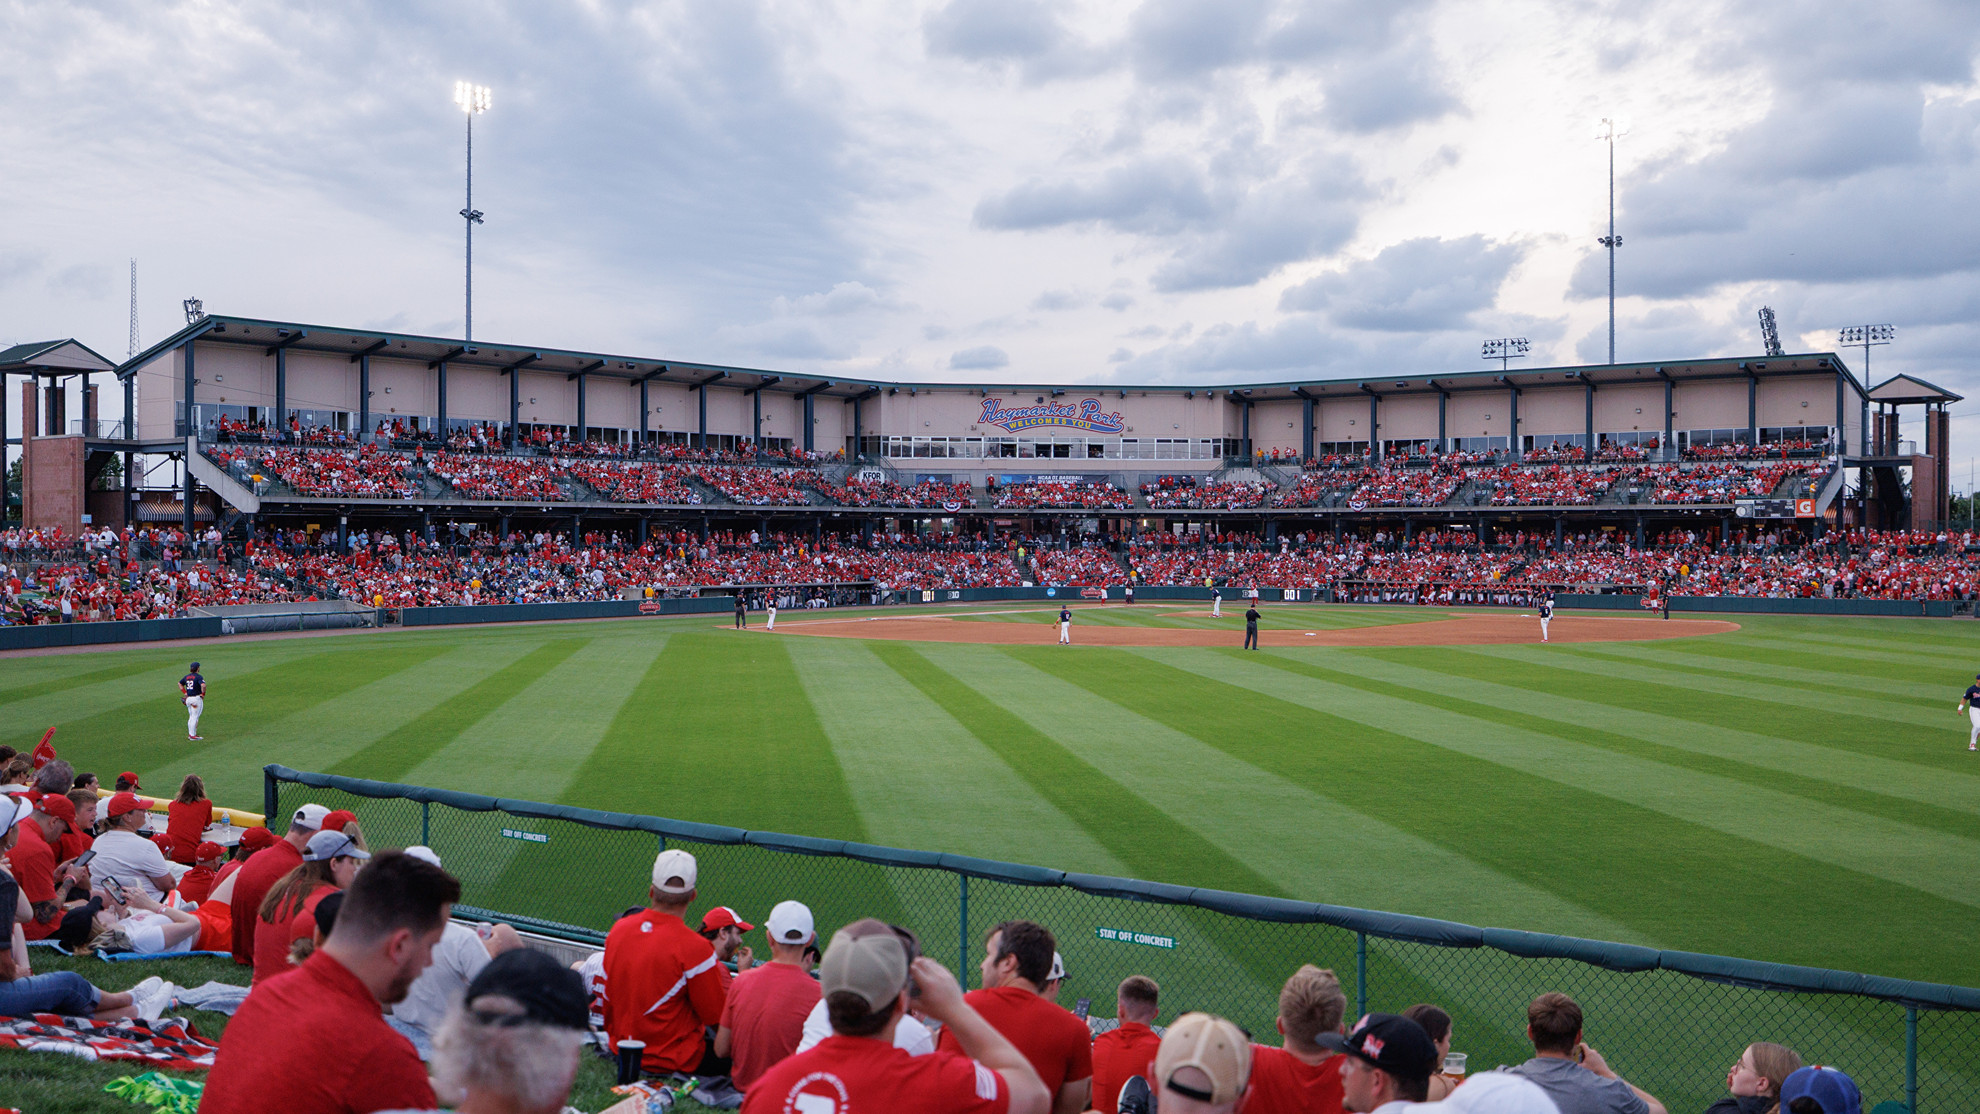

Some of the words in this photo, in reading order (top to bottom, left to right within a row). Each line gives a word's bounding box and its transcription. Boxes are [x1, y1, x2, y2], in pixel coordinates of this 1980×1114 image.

[977, 398, 1077, 423] Haymarket
[1079, 398, 1124, 428] Park
[1008, 418, 1067, 429] WELCOMES
[1072, 420, 1092, 429] YOU
[862, 472, 881, 480] KFOR
[1799, 501, 1811, 513] G
[186, 680, 194, 690] 32
[502, 829, 513, 838] STAY
[513, 831, 522, 839] OFF
[522, 832, 547, 843] CONCRETE
[1100, 928, 1117, 940] STAY
[1118, 931, 1133, 942] OFF
[1134, 933, 1173, 948] CONCRETE
